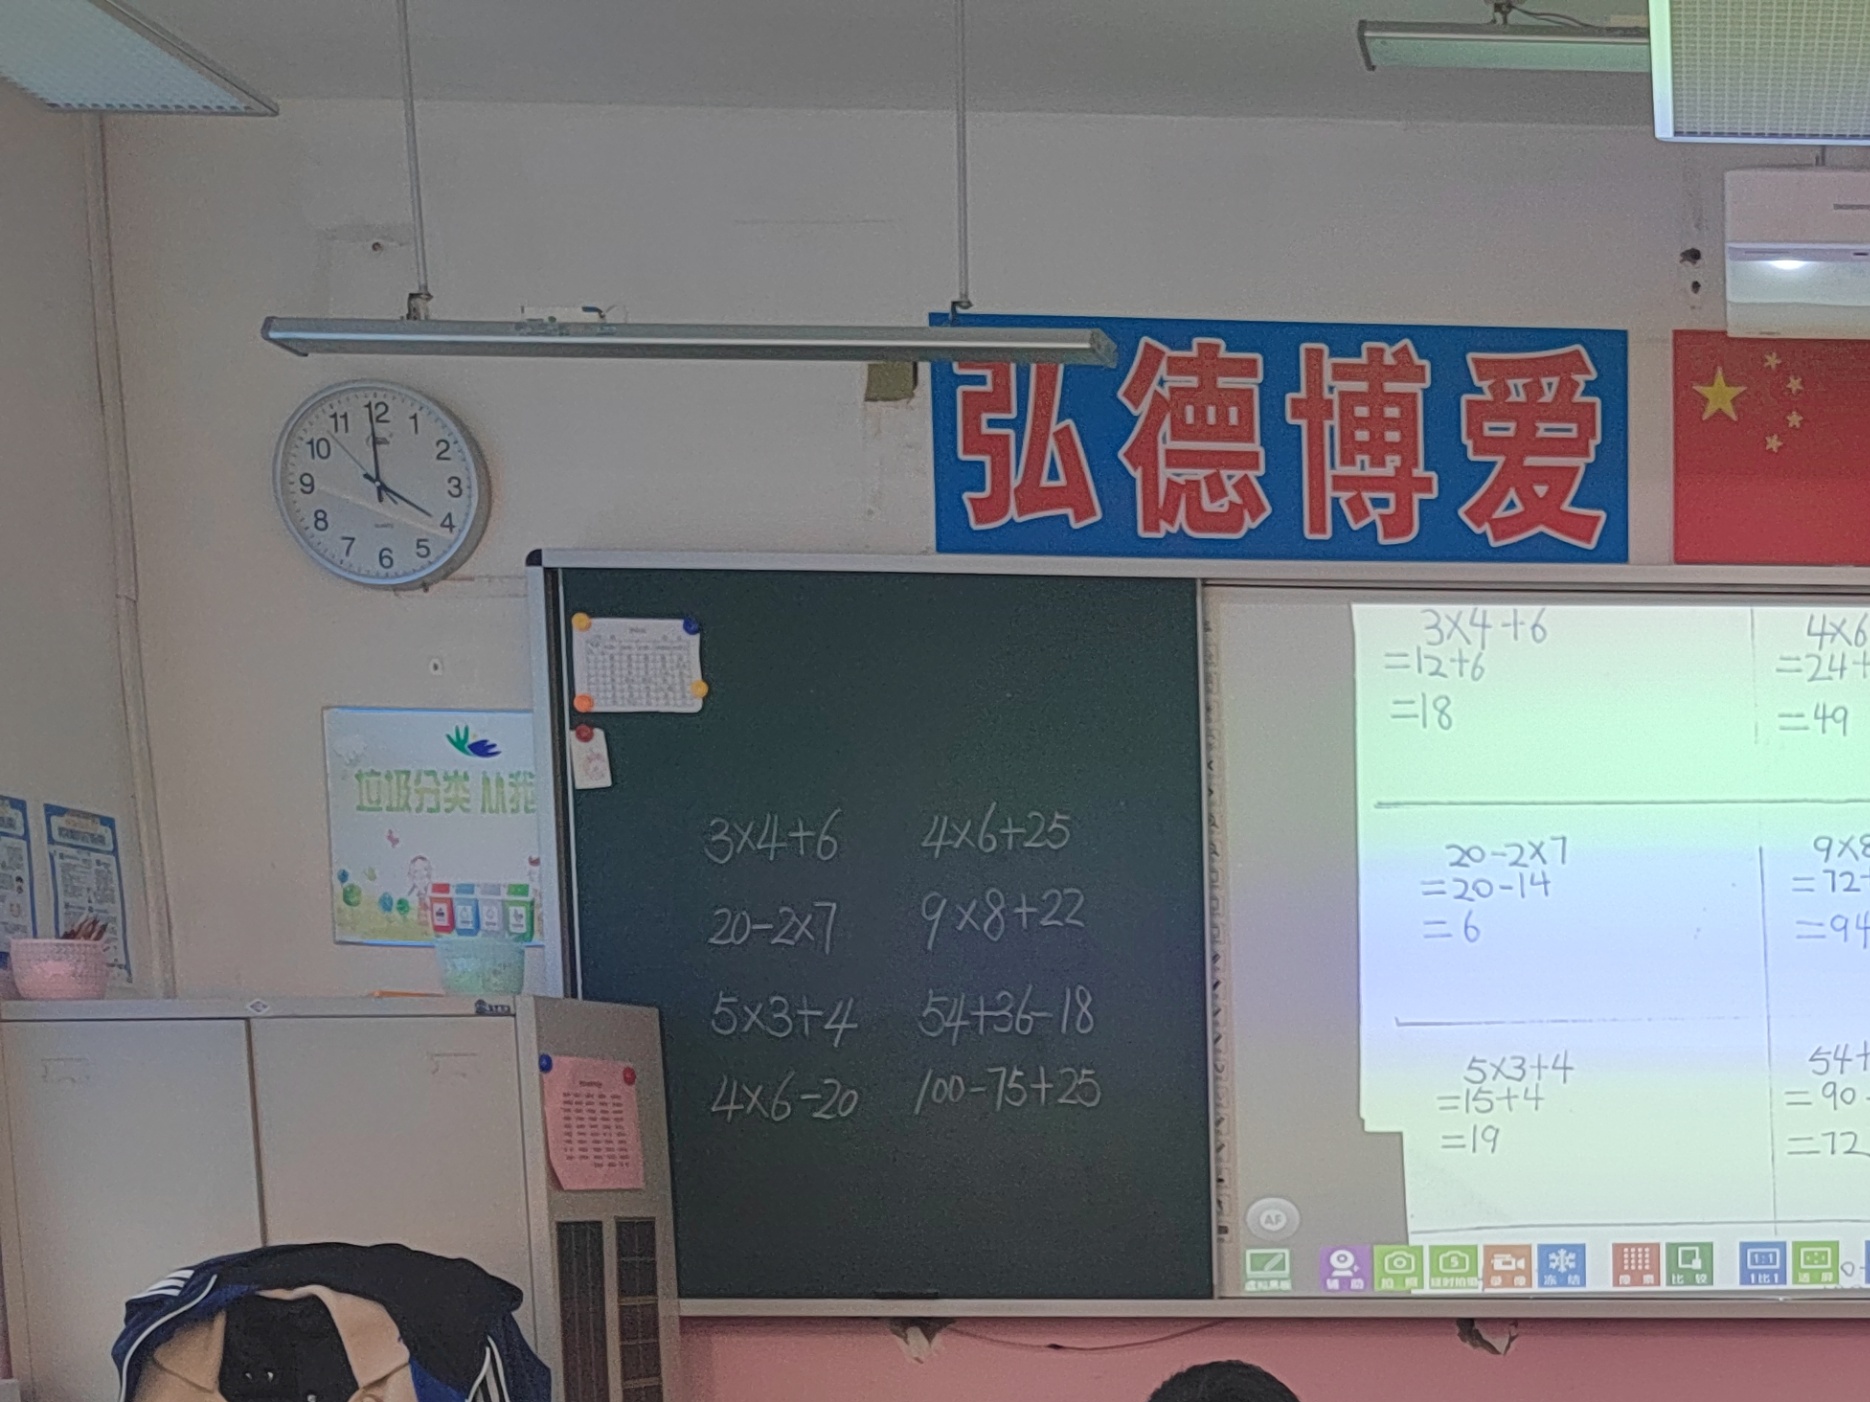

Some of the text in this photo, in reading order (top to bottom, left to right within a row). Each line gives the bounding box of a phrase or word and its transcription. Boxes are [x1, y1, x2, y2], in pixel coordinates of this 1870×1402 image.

[329, 411, 350, 434] 11
[364, 400, 391, 424] 12
[408, 412, 419, 435] 1
[306, 437, 331, 460] 10
[435, 439, 451, 461] 2
[952, 337, 1607, 549] 弘德博爱
[299, 472, 315, 495] 9
[447, 476, 463, 498] 3
[313, 509, 329, 531] 8
[439, 512, 456, 534] 4
[340, 536, 356, 557] 7
[378, 547, 394, 569] 6
[415, 538, 431, 559] 5
[1384, 646, 1486, 683] =12+6
[1390, 693, 1454, 732] =18
[1777, 702, 1850, 737] =49
[354, 768, 471, 815] 垃圾分类
[705, 808, 842, 864] 3×4+6
[920, 801, 1072, 857] 4×6+25
[1420, 871, 1552, 903] =20-14
[707, 901, 838, 955] 20-2×7
[920, 888, 1087, 952] 9×8+22
[710, 989, 858, 1047] 5×3+4
[917, 984, 1096, 1046] 54+36-18
[710, 1070, 859, 1124] 4×6-20
[914, 1065, 1102, 1116] 100-75+25
[1436, 1081, 1545, 1115] =15+4
[1440, 1124, 1501, 1155] =19
